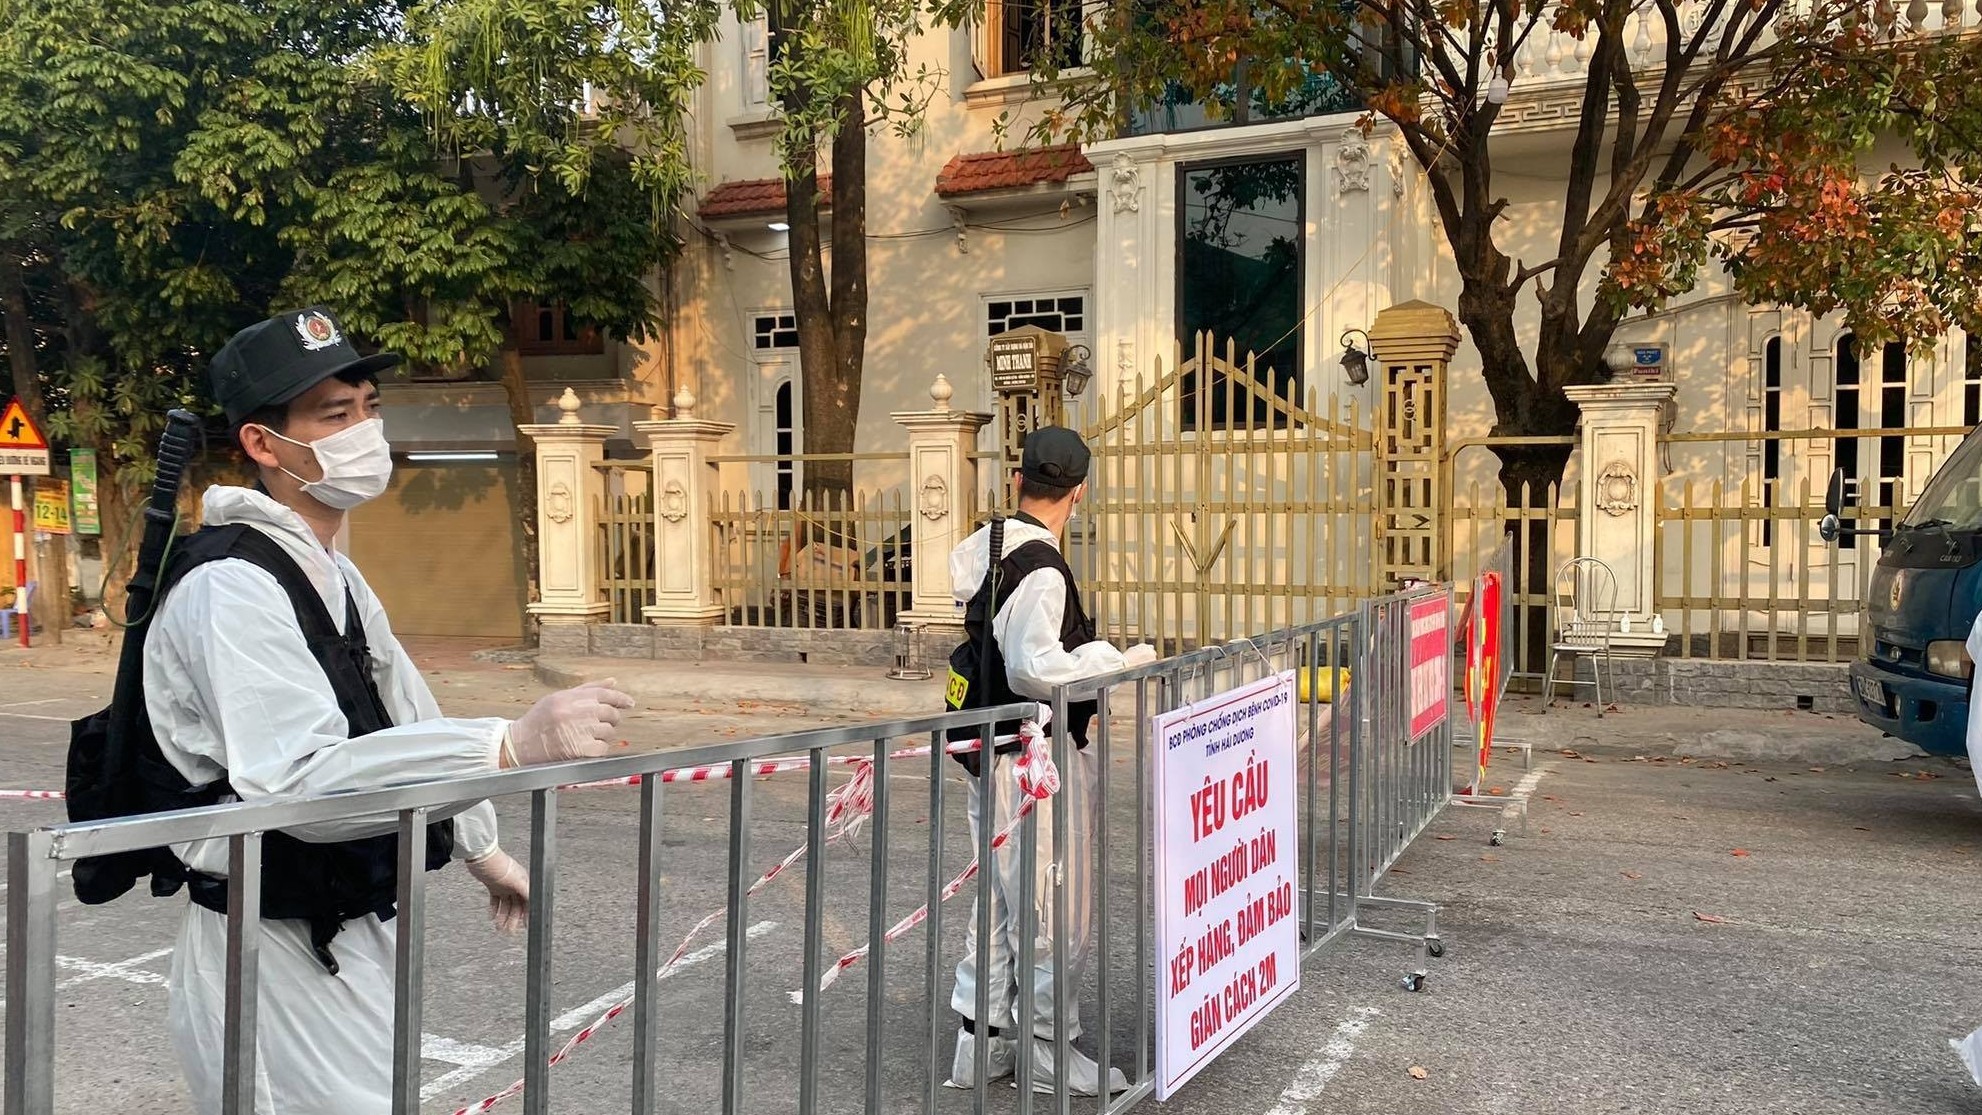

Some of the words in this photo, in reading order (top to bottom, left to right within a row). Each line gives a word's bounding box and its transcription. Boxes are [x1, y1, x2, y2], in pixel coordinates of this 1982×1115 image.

[1168, 732, 1182, 750] BCĐ
[1182, 723, 1207, 744] PHÒNG
[1207, 711, 1232, 734] CHỐNG
[1232, 708, 1247, 727] DỊCH
[1247, 701, 1262, 721] BỆNH
[1262, 691, 1288, 712] COVID-19
[1205, 739, 1220, 757] TỈNH
[1221, 731, 1232, 751] HẢI
[1190, 775, 1226, 844] YÊU
[1231, 749, 1269, 822] CẦU
[1184, 869, 1208, 918] MỌI
[1211, 837, 1248, 899] NGƯỜI
[1251, 826, 1276, 875] DÂN
[1170, 937, 1194, 1000] XẾP
[1198, 923, 1235, 977] HÀNG,
[1237, 892, 1264, 948] ĐẢM
[1267, 874, 1292, 929] BẢO
[1190, 992, 1222, 1051] GIÃN
[1225, 970, 1257, 1024] CÁCH
[1259, 952, 1277, 997] 2M
